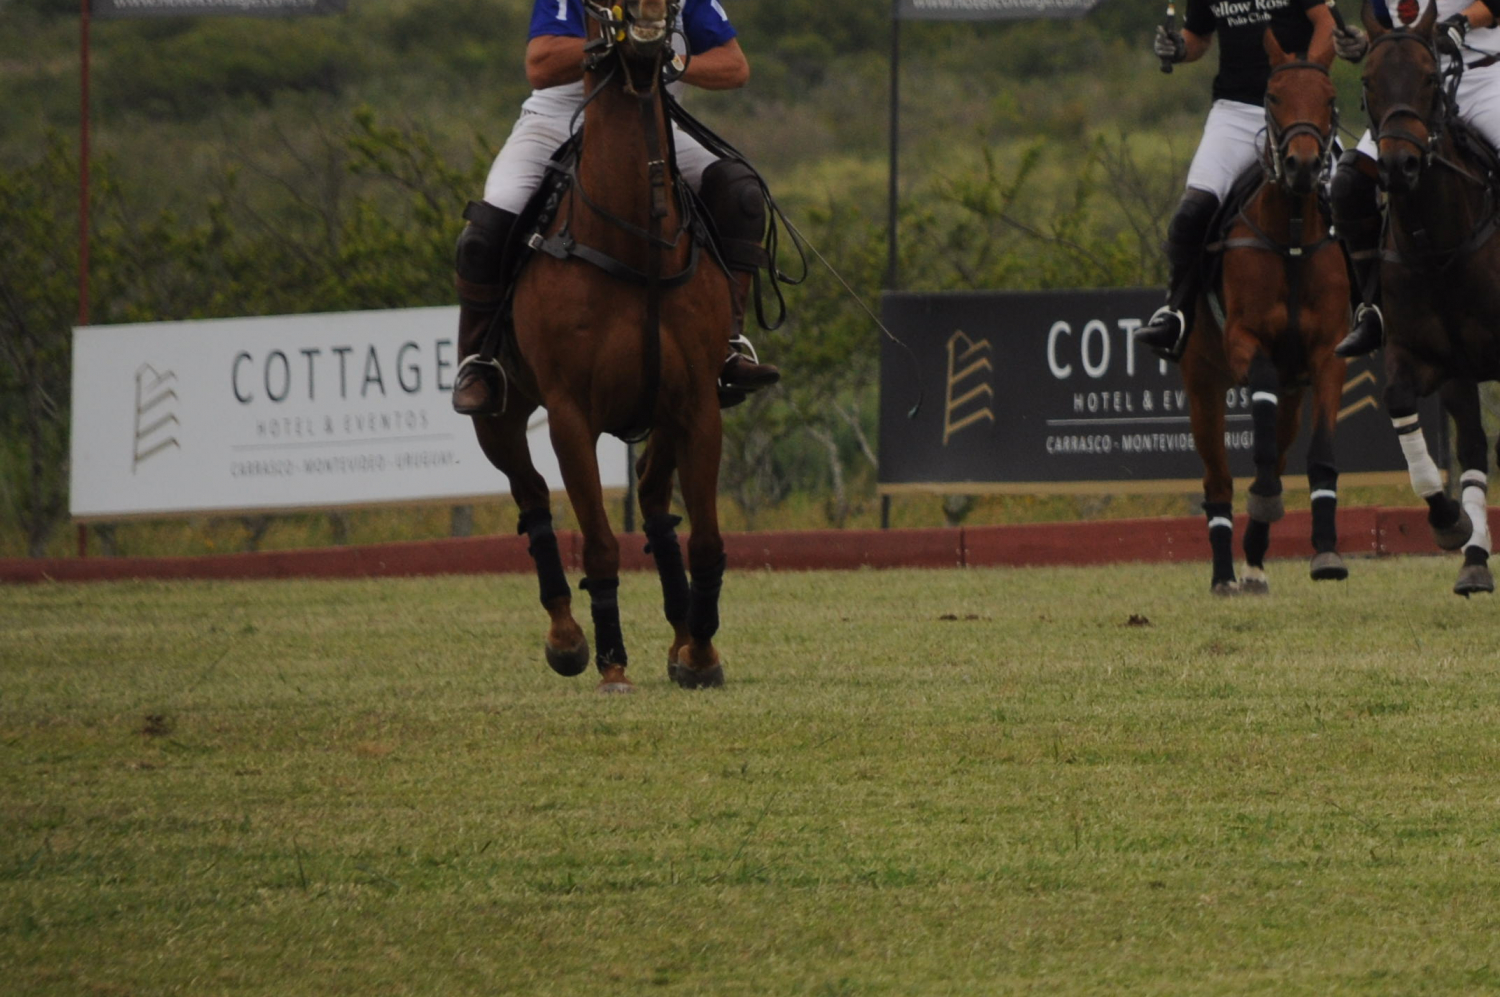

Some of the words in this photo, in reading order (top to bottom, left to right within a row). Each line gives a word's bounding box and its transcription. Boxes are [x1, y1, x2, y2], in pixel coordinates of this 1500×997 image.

[231, 338, 453, 405] COTTAGE
[1073, 390, 1133, 413] HOTEL
[1142, 388, 1153, 411] &
[257, 415, 315, 438] HOTEL
[344, 409, 429, 433] EVENTOS
[1046, 434, 1112, 454] CARRASCO
[1121, 432, 1197, 452] MONTEVIDE
